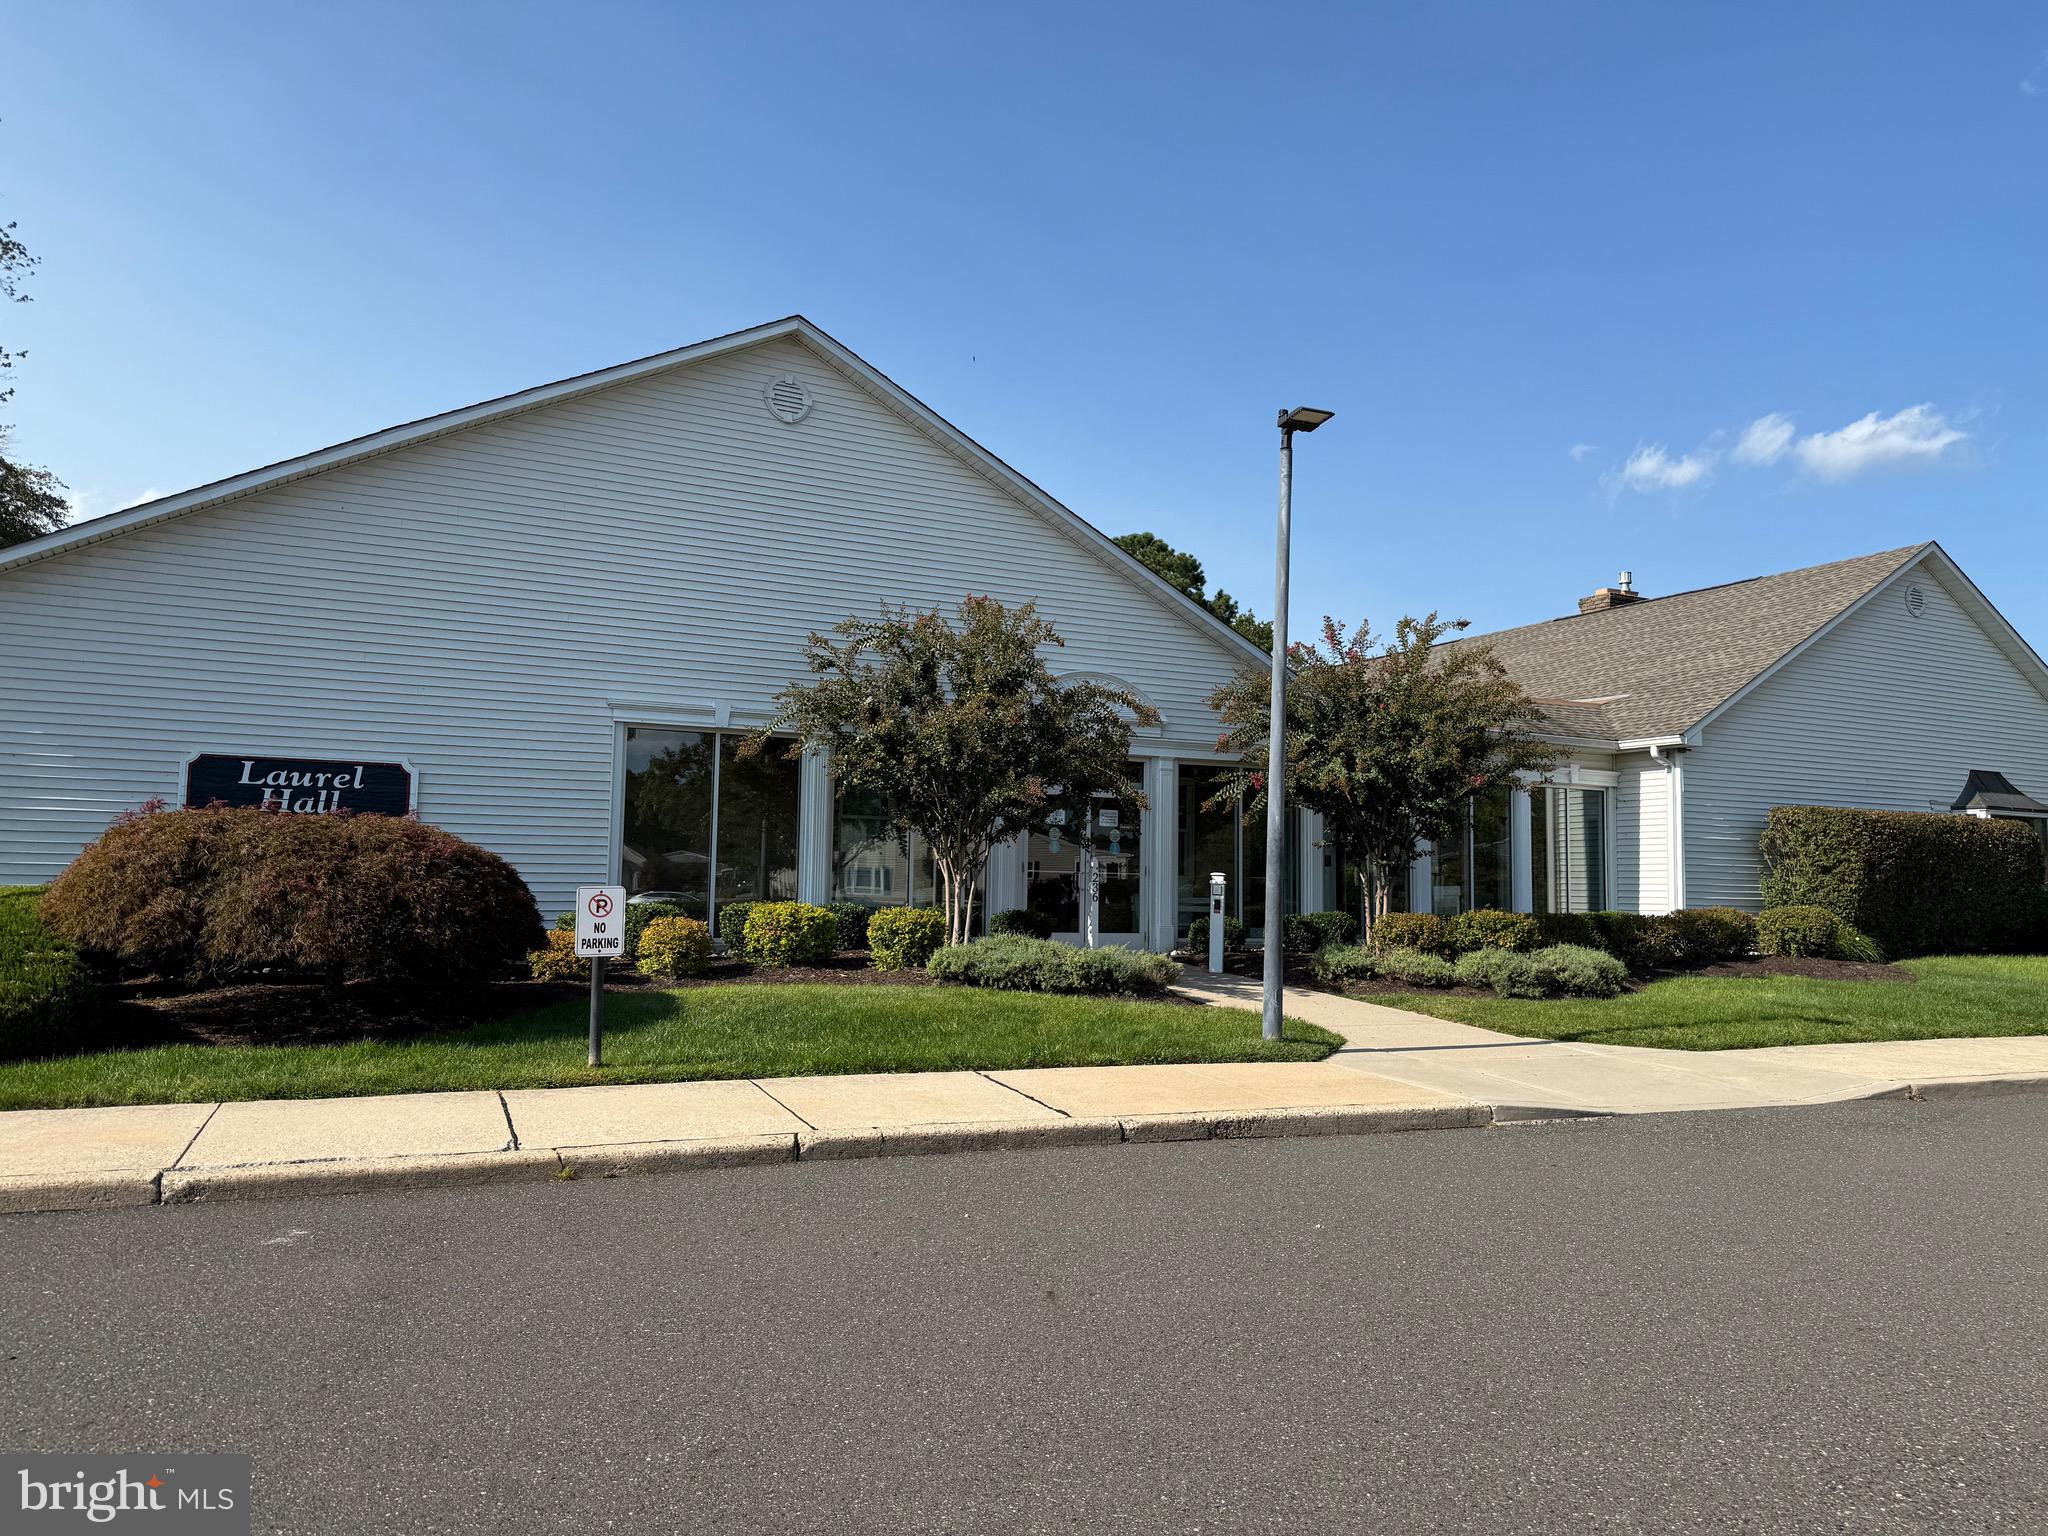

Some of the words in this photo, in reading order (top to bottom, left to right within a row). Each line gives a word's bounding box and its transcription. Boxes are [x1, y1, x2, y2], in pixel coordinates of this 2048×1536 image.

[237, 760, 365, 789] Laurel
[259, 787, 341, 814] Hall
[593, 922, 607, 934] NO
[581, 937, 619, 950] PARKING
